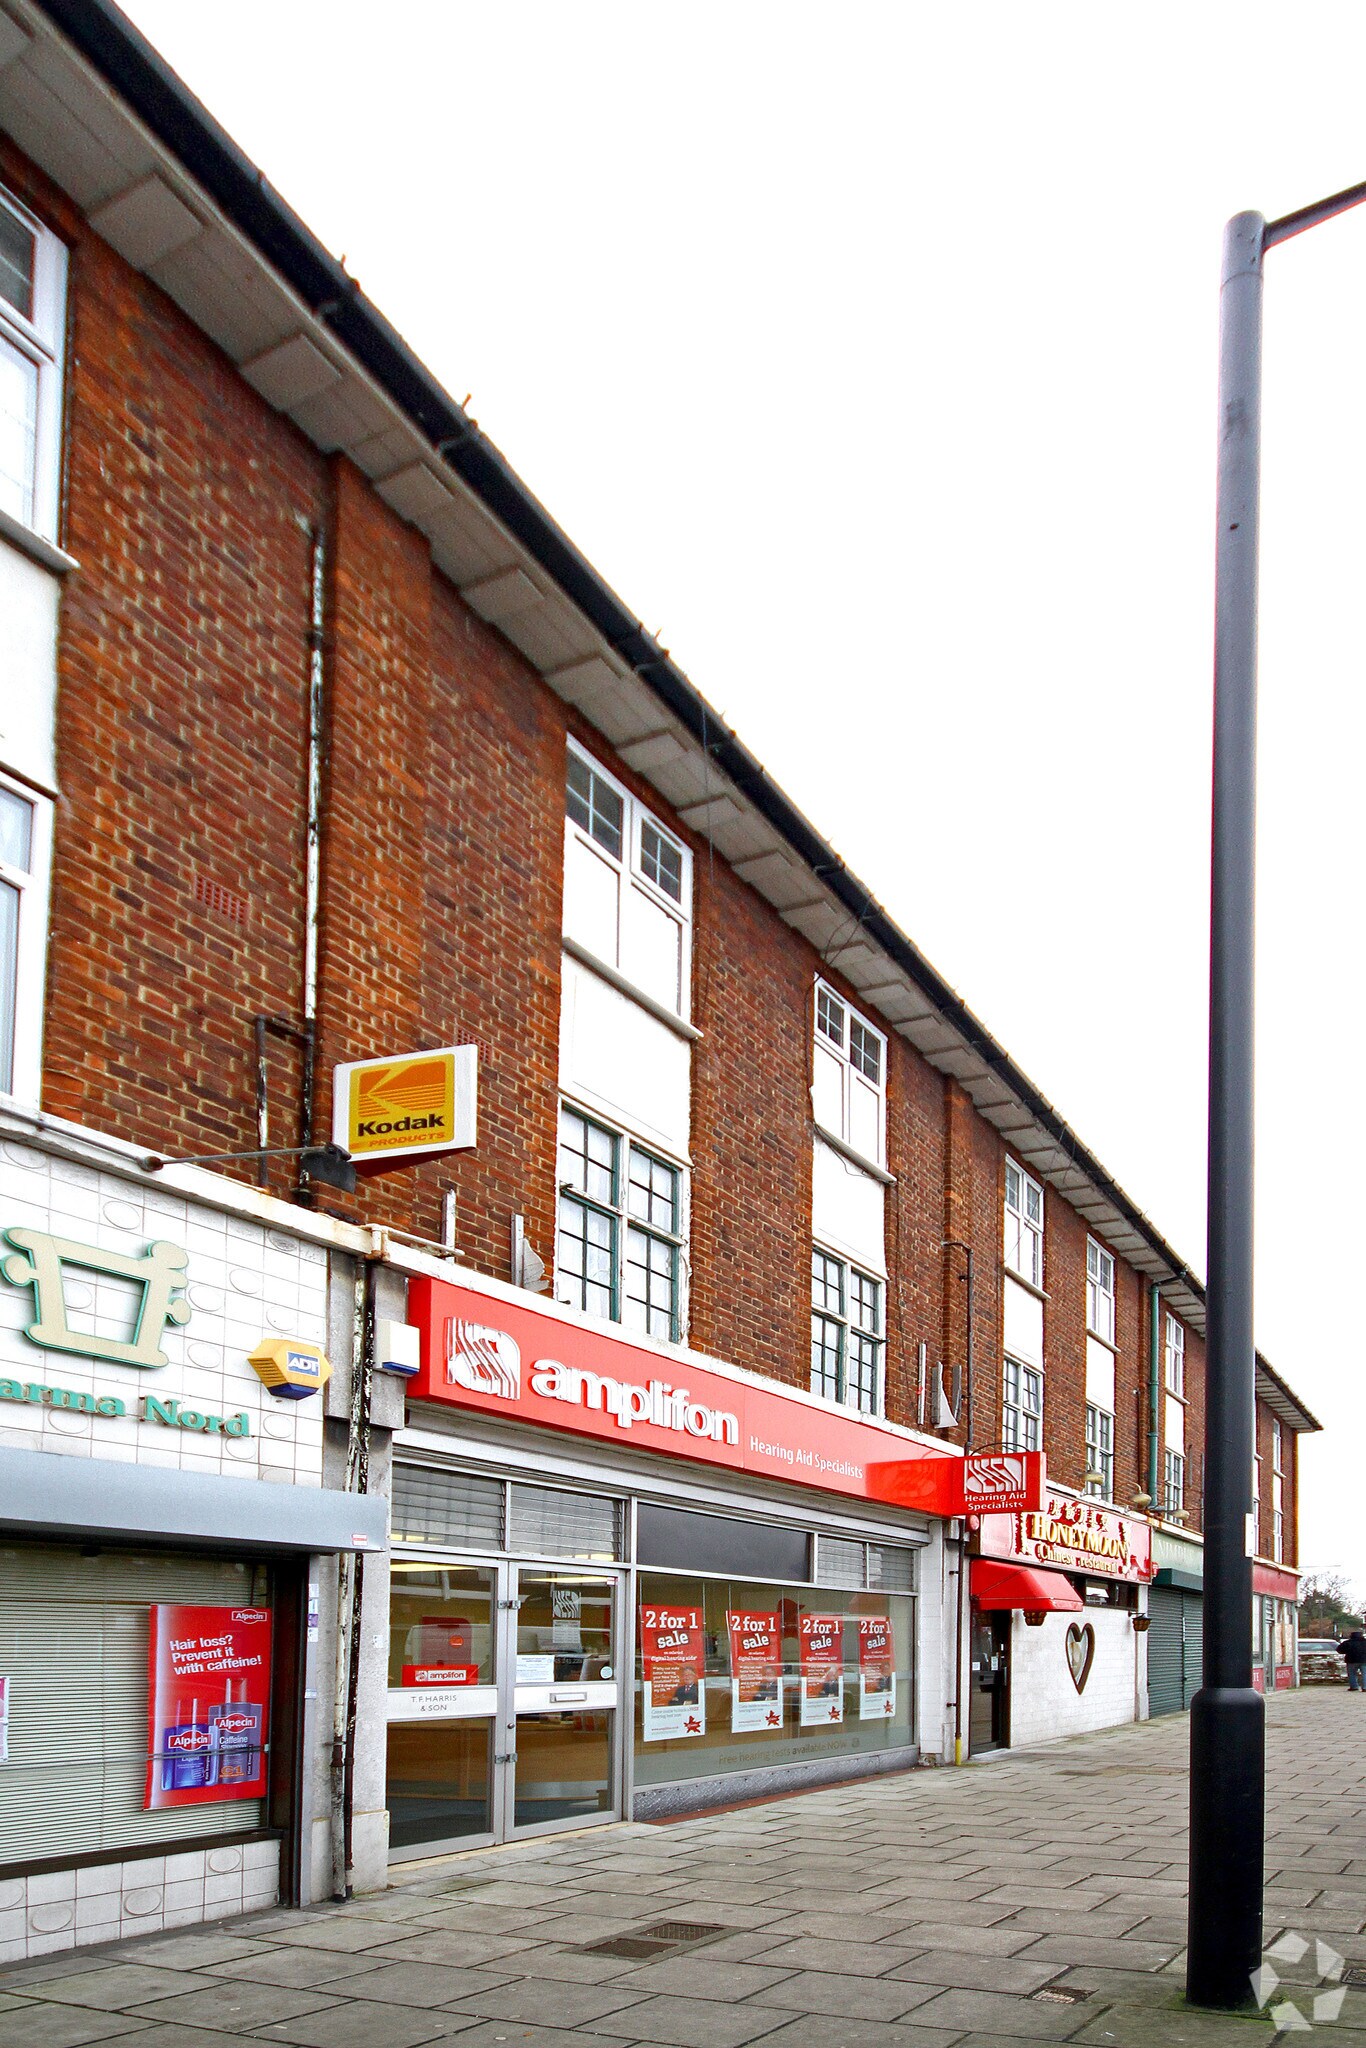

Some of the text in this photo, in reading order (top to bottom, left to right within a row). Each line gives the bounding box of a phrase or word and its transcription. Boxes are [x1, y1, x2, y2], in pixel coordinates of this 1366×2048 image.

[357, 1113, 445, 1137] Kodak
[368, 1131, 445, 1148] PRODUCTS
[287, 1356, 319, 1373] ADT
[530, 1358, 740, 1446] amplifon
[138, 1394, 250, 1438] Nord
[749, 1435, 864, 1479] Hearing Aid Specialists
[964, 1491, 1027, 1502] Hearing Aid
[967, 1501, 1024, 1511] Specialists
[1030, 1512, 1129, 1560] HONEYMOON
[1036, 1542, 1076, 1566] Chinese
[235, 1612, 264, 1621] Alpecin
[645, 1610, 699, 1629] 2 for 1
[731, 1615, 776, 1632] 2 for 1
[802, 1618, 840, 1634] 2 for 1
[860, 1620, 892, 1634] 2 for 1
[169, 1634, 233, 1651] Hair loss?
[657, 1630, 689, 1649] sale
[742, 1632, 770, 1650] sale
[809, 1635, 833, 1651] sale
[866, 1634, 886, 1649] sale
[171, 1646, 235, 1663] Prevent it
[173, 1655, 262, 1675] with caffeine!
[429, 1671, 465, 1680] amplifon
[425, 1694, 457, 1703] HARRIS
[428, 1704, 447, 1712] SON
[218, 1718, 253, 1730] Alpecin
[173, 1735, 208, 1747] Alpecin
[219, 1735, 249, 1745] Caffeine
